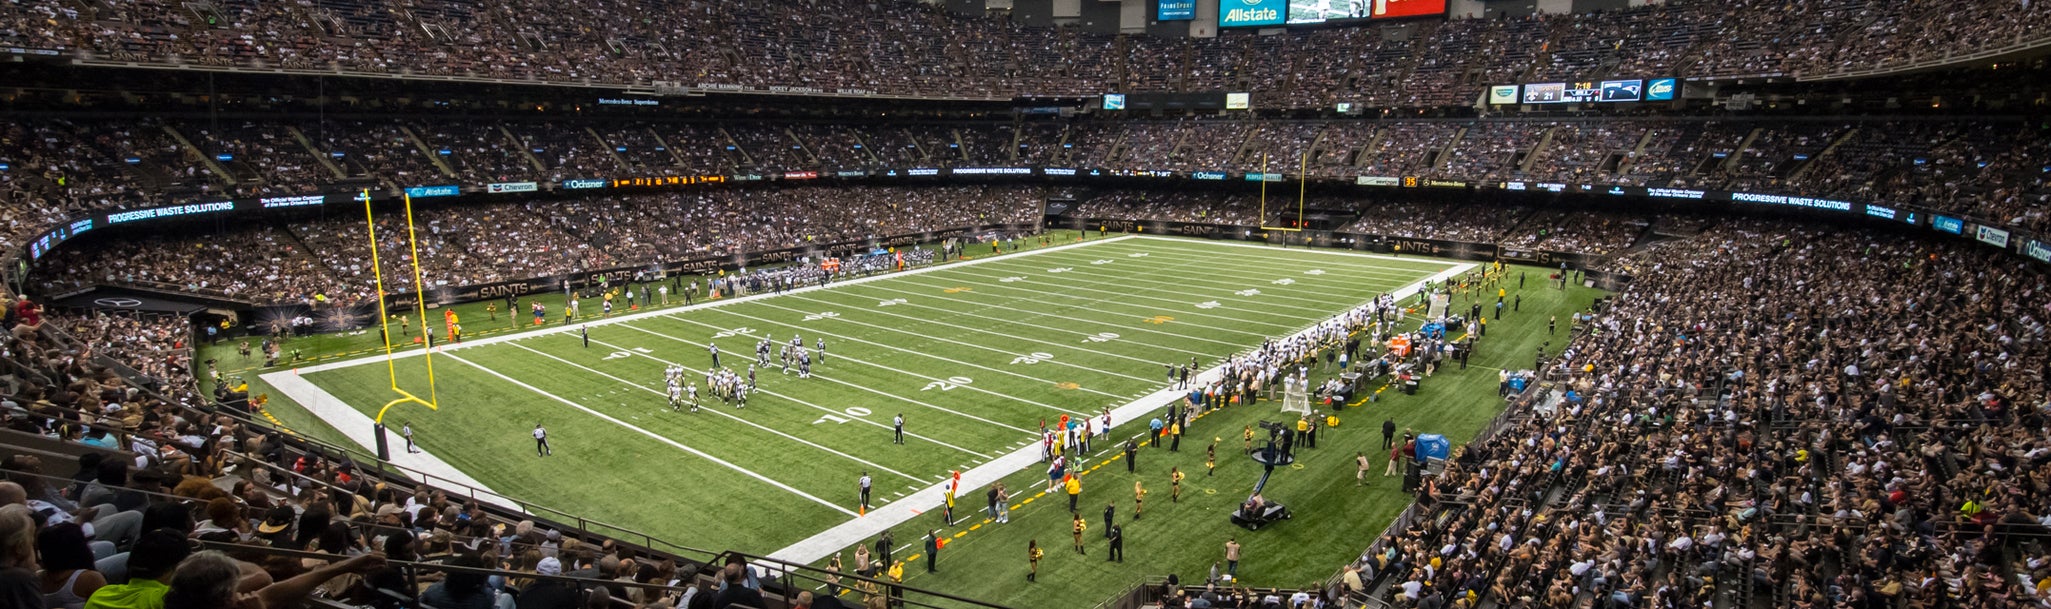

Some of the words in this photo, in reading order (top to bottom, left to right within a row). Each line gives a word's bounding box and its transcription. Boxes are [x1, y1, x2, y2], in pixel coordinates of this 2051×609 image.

[1224, 8, 1277, 22] Allstate
[1543, 92, 1554, 100] 21
[1608, 90, 1615, 98] 7
[1197, 172, 1224, 180] Ochsner
[1405, 177, 1416, 187] 35
[570, 179, 604, 189] Ochsner
[1732, 193, 1787, 204] PROGRESSIVE
[1788, 197, 1813, 207] WASTE
[1813, 199, 1850, 211] SOLUTIONS
[107, 209, 156, 224] PROGRESSIVE
[156, 206, 184, 217] WASTE
[184, 201, 233, 213] SOLUTIONS
[1183, 225, 1214, 234] SAINT
[1389, 240, 1431, 253] AINTS
[591, 270, 631, 284] SINTS
[480, 283, 528, 298] SAINTS
[919, 376, 973, 391] 20
[812, 407, 872, 425] 10
